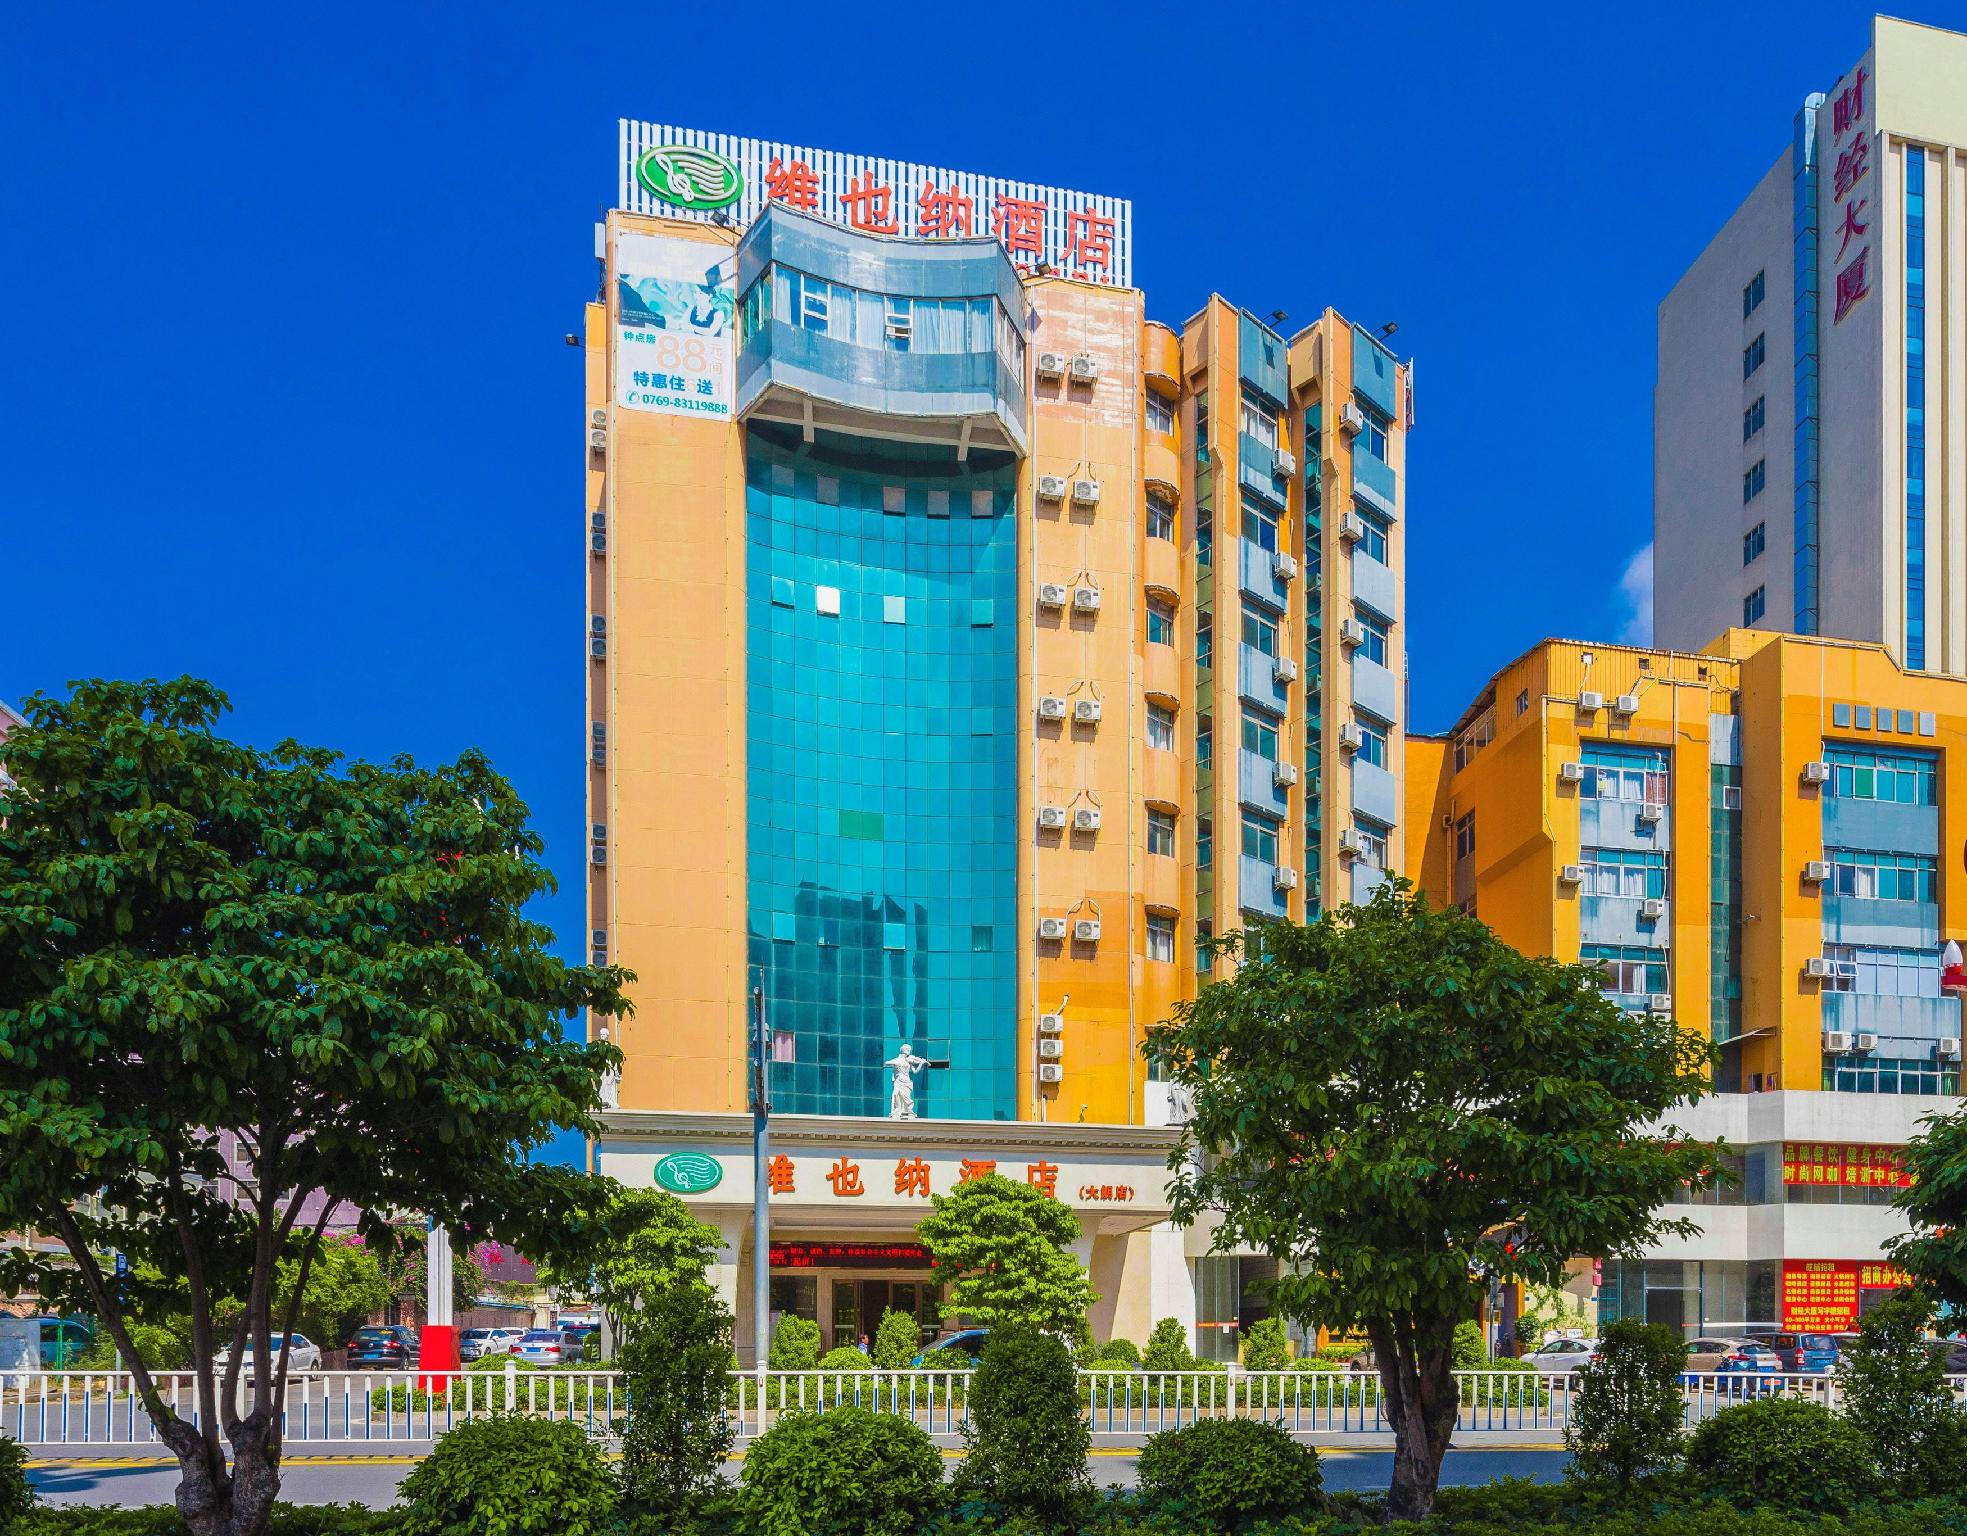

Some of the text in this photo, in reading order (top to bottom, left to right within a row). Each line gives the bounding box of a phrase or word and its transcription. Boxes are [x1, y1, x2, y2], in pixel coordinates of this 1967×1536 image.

[764, 155, 1116, 269] 维也纳酒店
[1833, 66, 1870, 325] 财经大厦
[623, 330, 656, 345] 钟点房
[656, 334, 707, 374] 88
[642, 394, 728, 414] 0769-83119888
[1783, 1165, 1839, 1182] 时尚网咖
